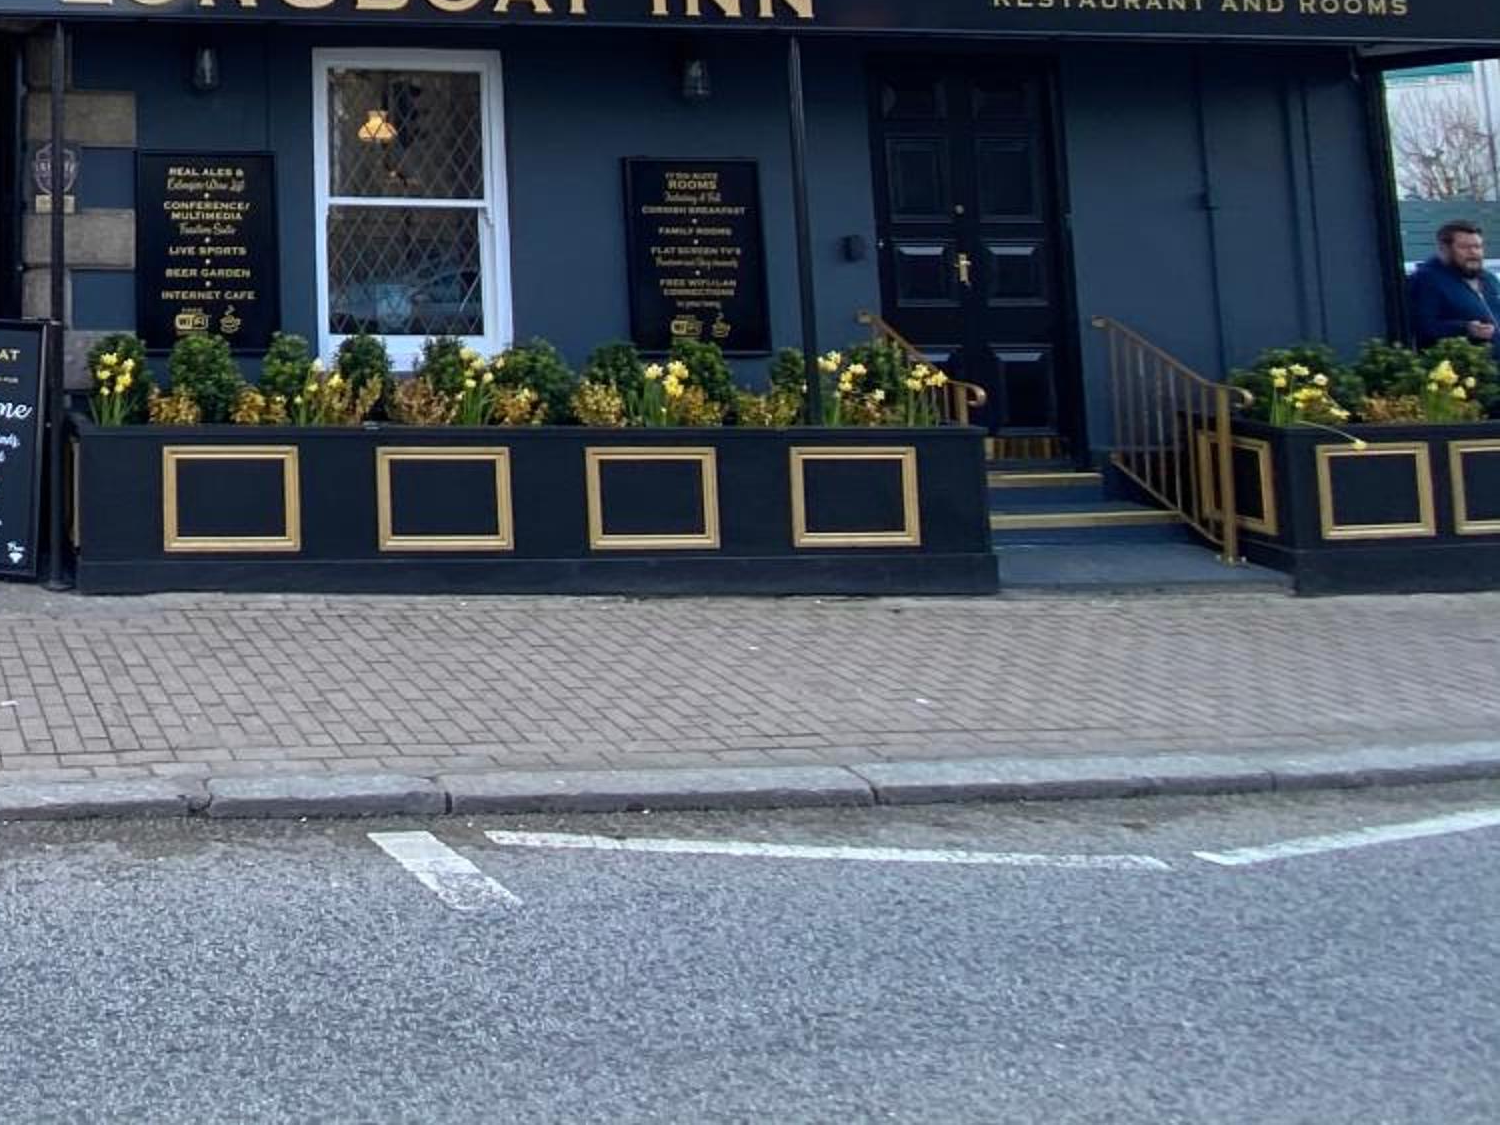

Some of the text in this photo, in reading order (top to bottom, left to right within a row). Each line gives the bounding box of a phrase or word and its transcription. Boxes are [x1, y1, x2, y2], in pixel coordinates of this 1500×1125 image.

[169, 167, 199, 176] REAL
[202, 167, 233, 176] ALES
[668, 180, 717, 190] ROOMS
[171, 211, 243, 220] MULTIMEDIA
[658, 226, 694, 236] FAMILY
[169, 246, 248, 256] LIVE SPORTS
[165, 268, 251, 278] BEER GARDEN
[161, 290, 221, 300] INTERNET
